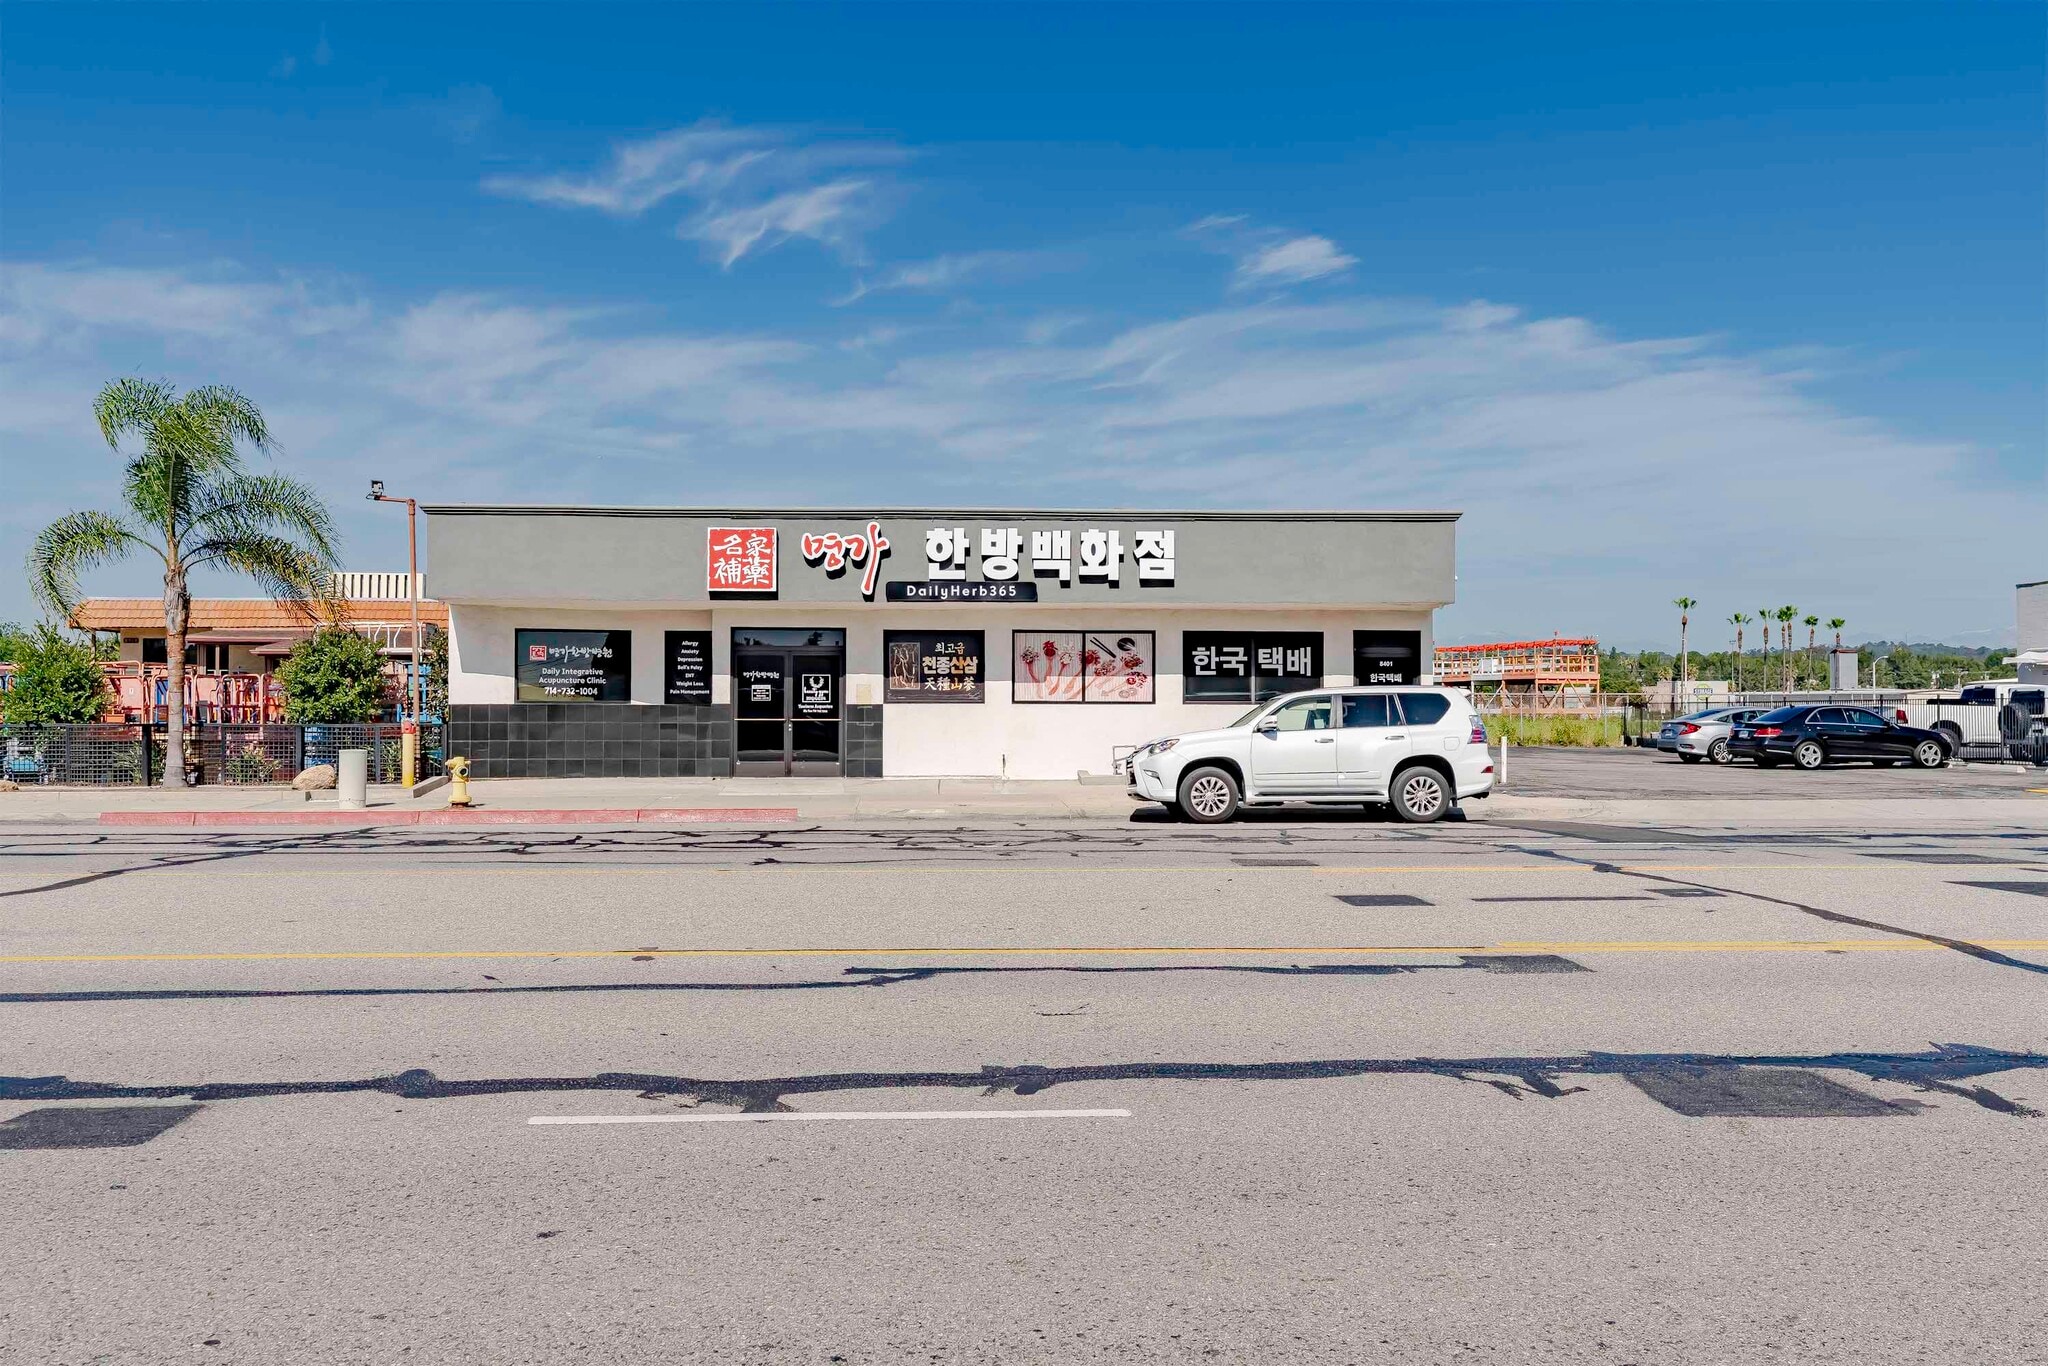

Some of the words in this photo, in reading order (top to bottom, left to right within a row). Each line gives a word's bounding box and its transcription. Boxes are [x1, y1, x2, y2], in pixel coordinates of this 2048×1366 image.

[713, 533, 771, 557] 名家
[801, 522, 890, 596] 명가
[925, 527, 1175, 582] 한방백화점
[713, 557, 770, 585] 補藥
[906, 585, 1017, 599] DailyHerb365
[934, 642, 966, 655] 최고급
[922, 656, 978, 675] 천종산삼
[542, 668, 560, 677] Daily
[562, 668, 604, 677] Integrative
[1369, 673, 1402, 683] 한국택배
[539, 677, 585, 685] Acupuncture
[544, 687, 598, 696] 714-732-1004
